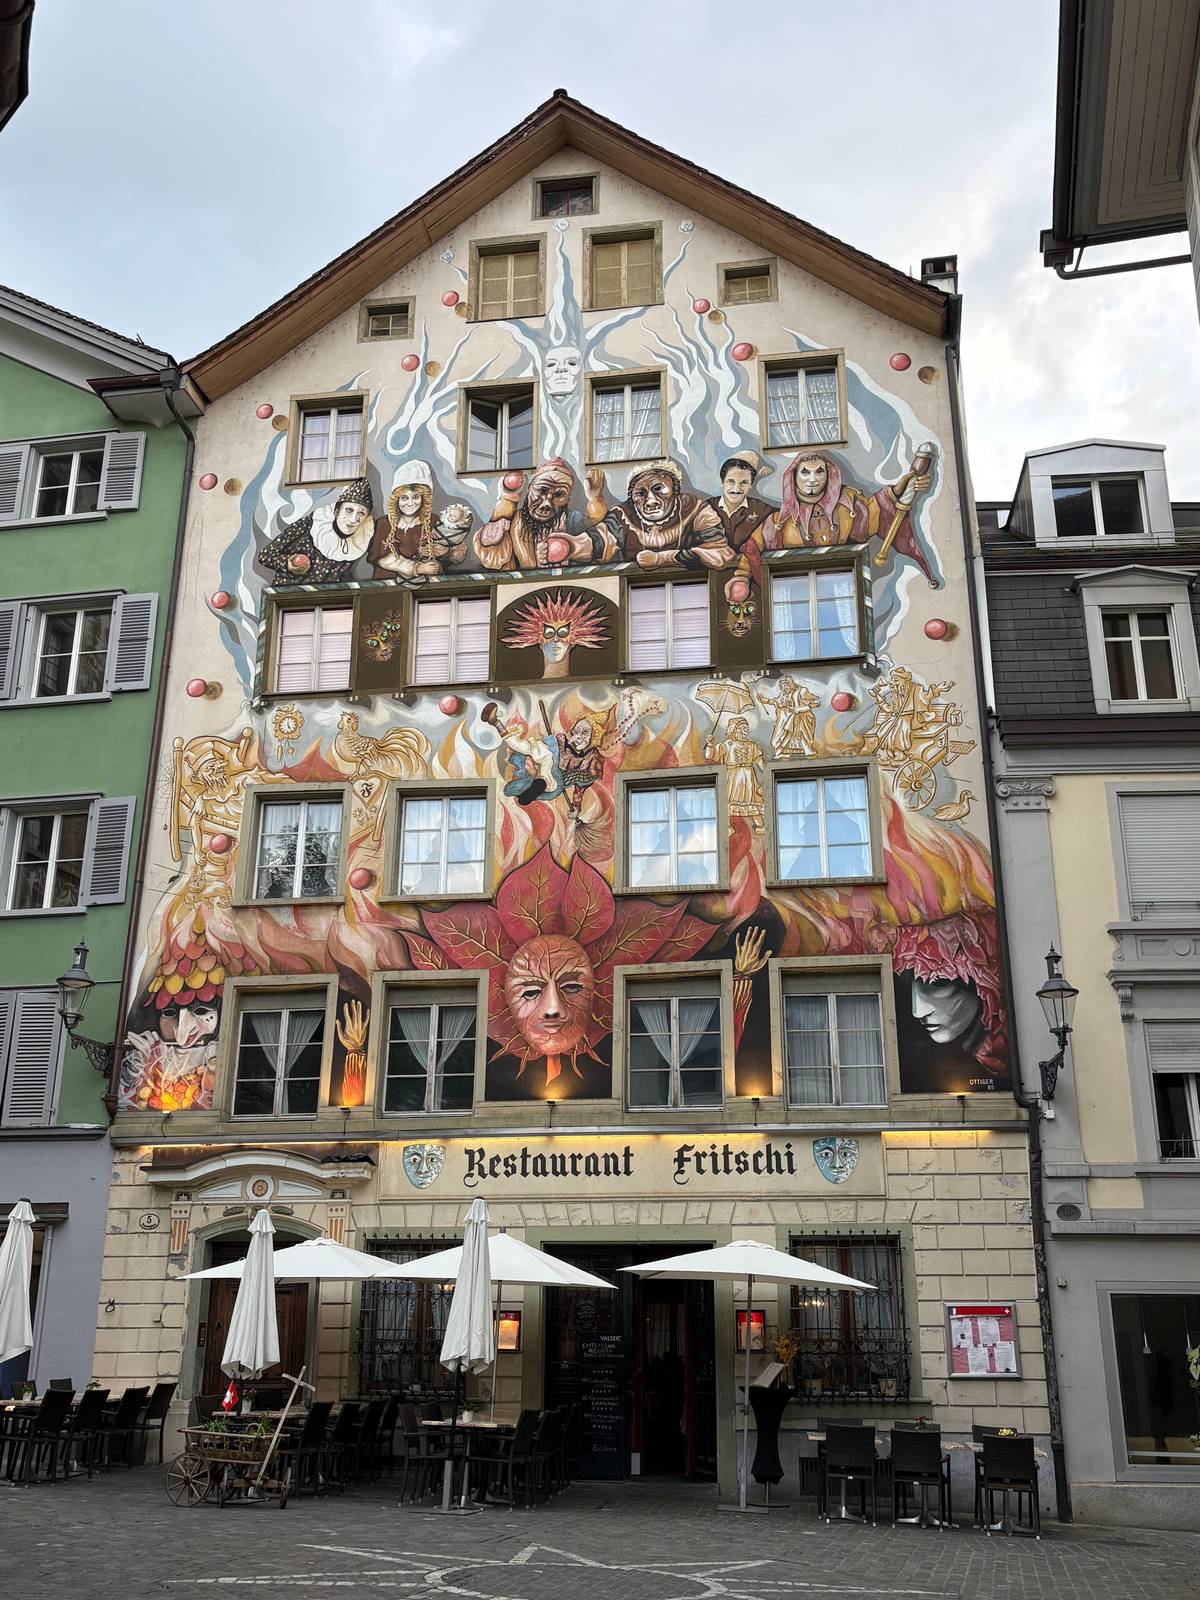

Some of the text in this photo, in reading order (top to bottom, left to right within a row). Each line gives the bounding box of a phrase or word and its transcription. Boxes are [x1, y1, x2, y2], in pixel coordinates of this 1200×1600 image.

[463, 1142, 797, 1188] Restaurant Fritschi
[146, 1215, 152, 1224] 5
